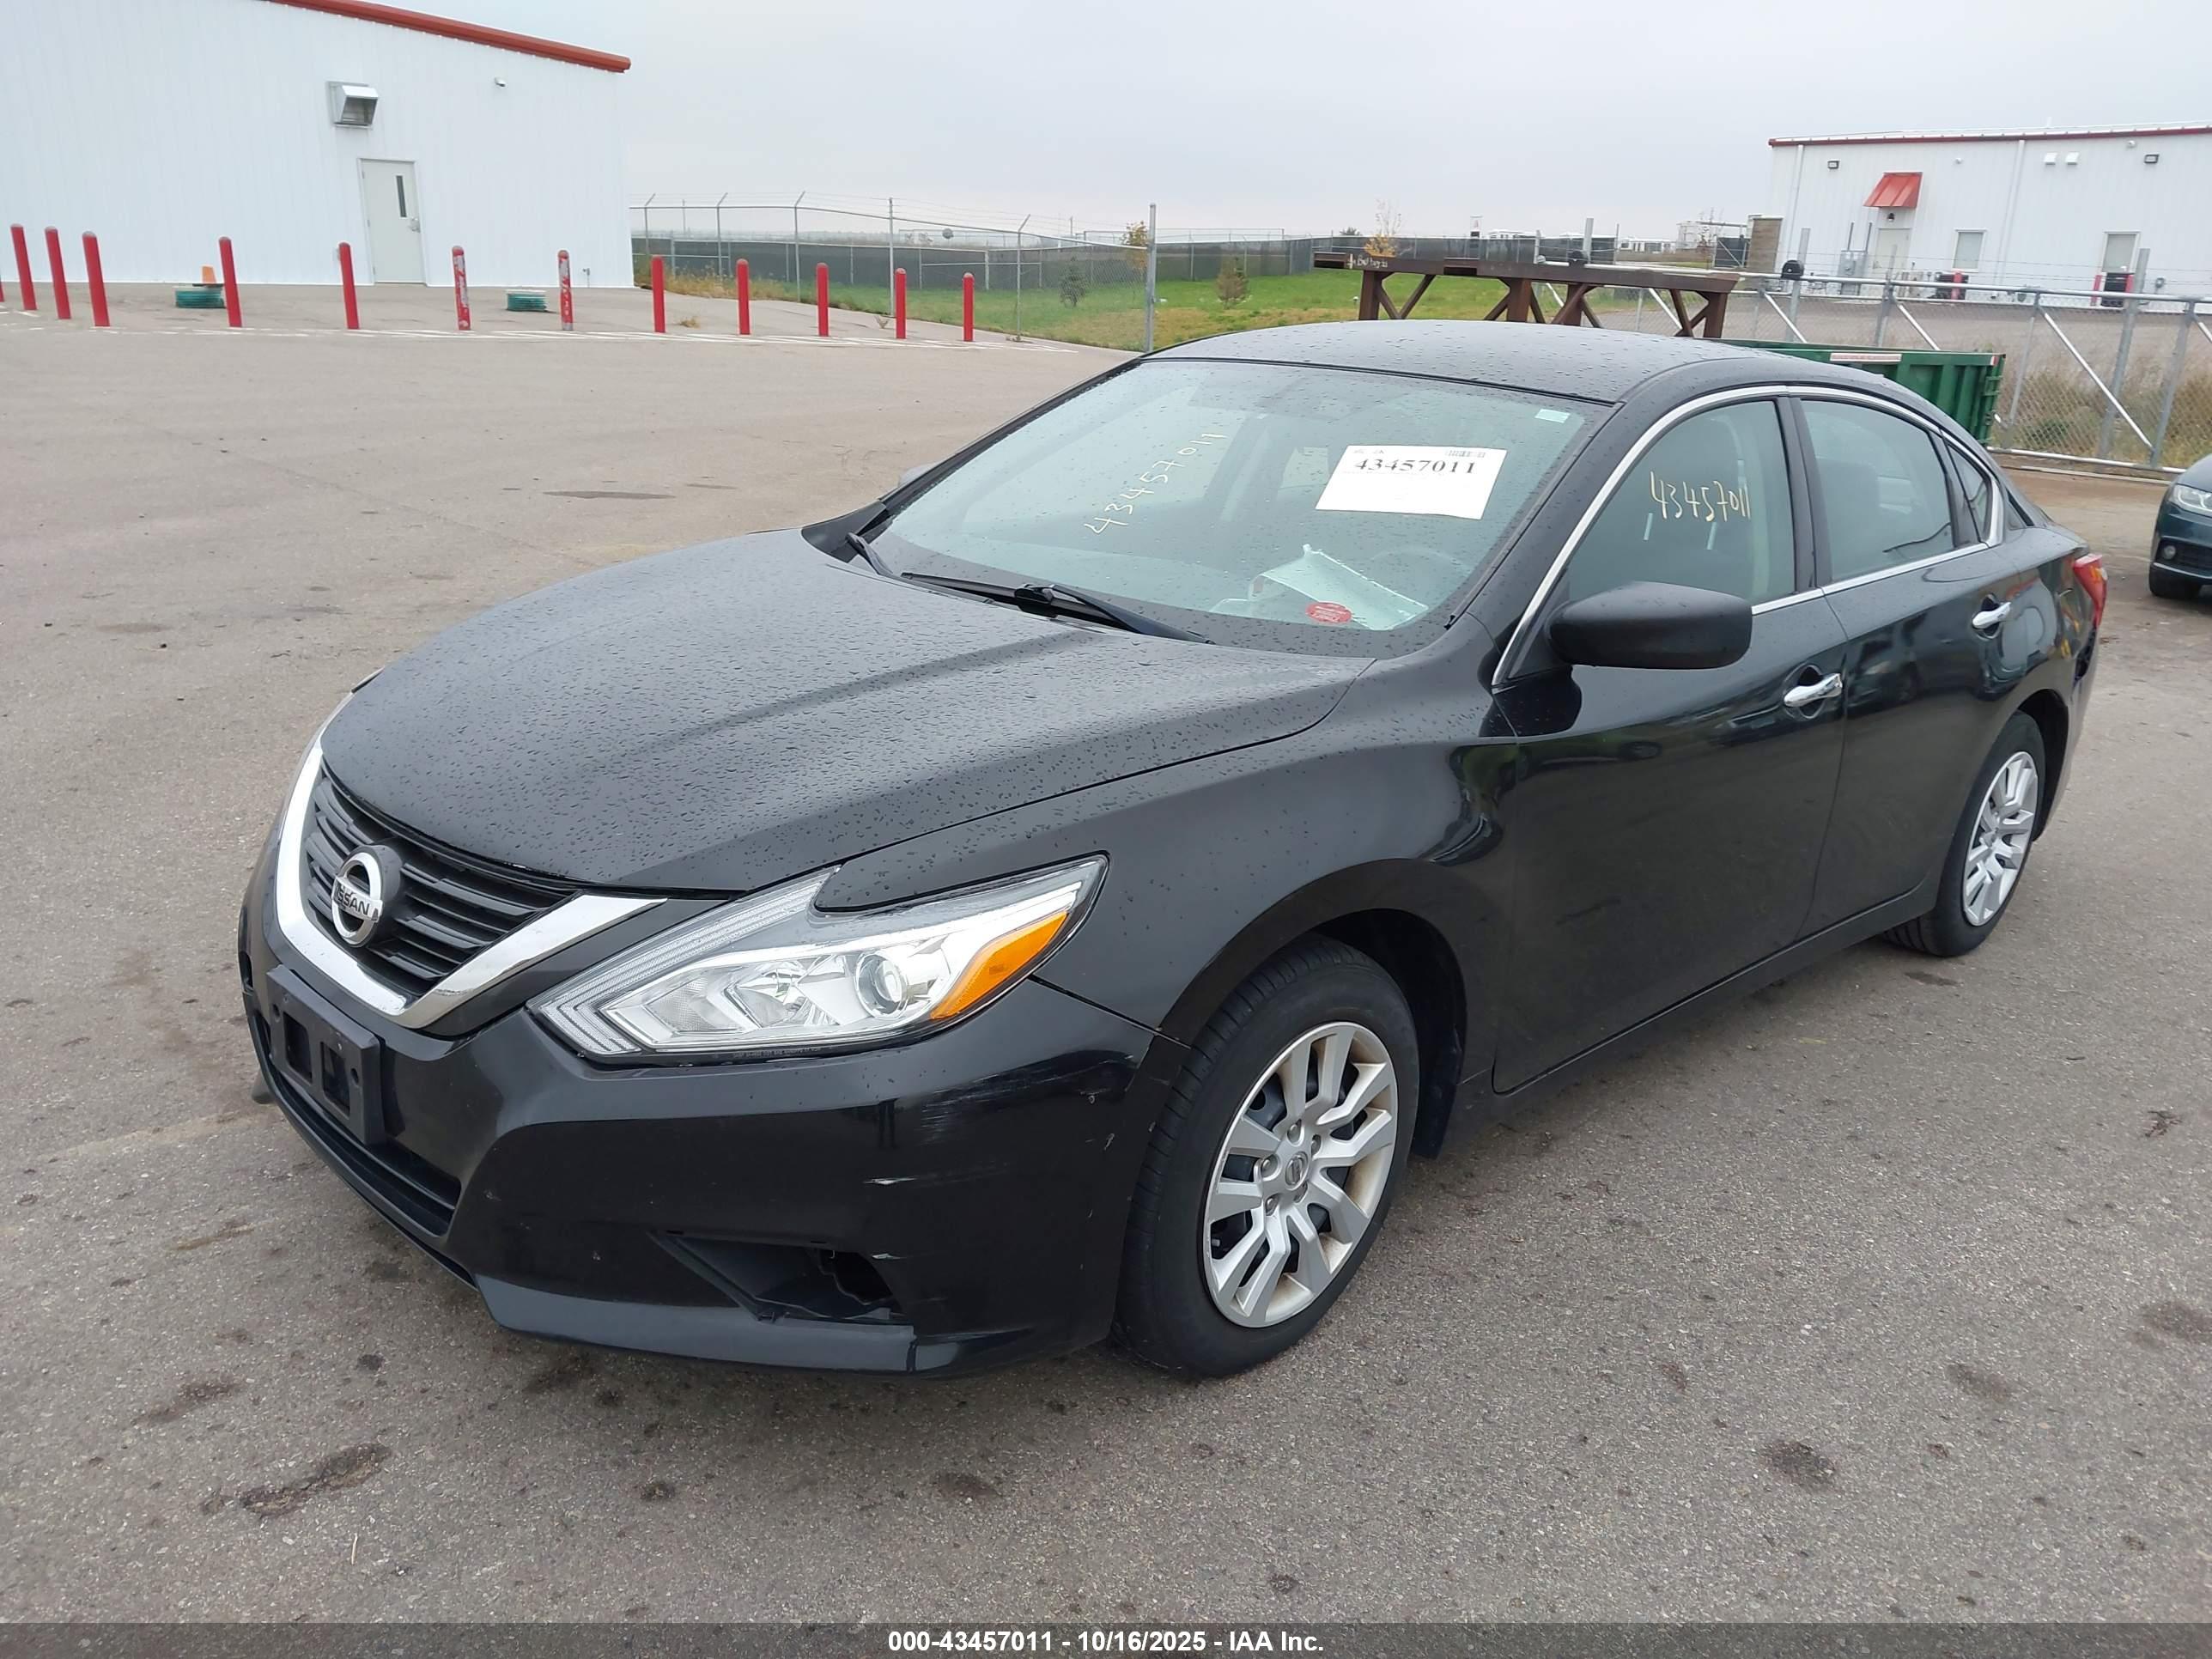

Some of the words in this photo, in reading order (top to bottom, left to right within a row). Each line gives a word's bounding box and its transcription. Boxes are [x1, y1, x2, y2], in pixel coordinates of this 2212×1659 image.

[1084, 433, 1230, 534] 43457011
[1354, 458, 1476, 474] 43457011
[1650, 471, 1751, 522] 43457011
[334, 879, 371, 916] SSAN
